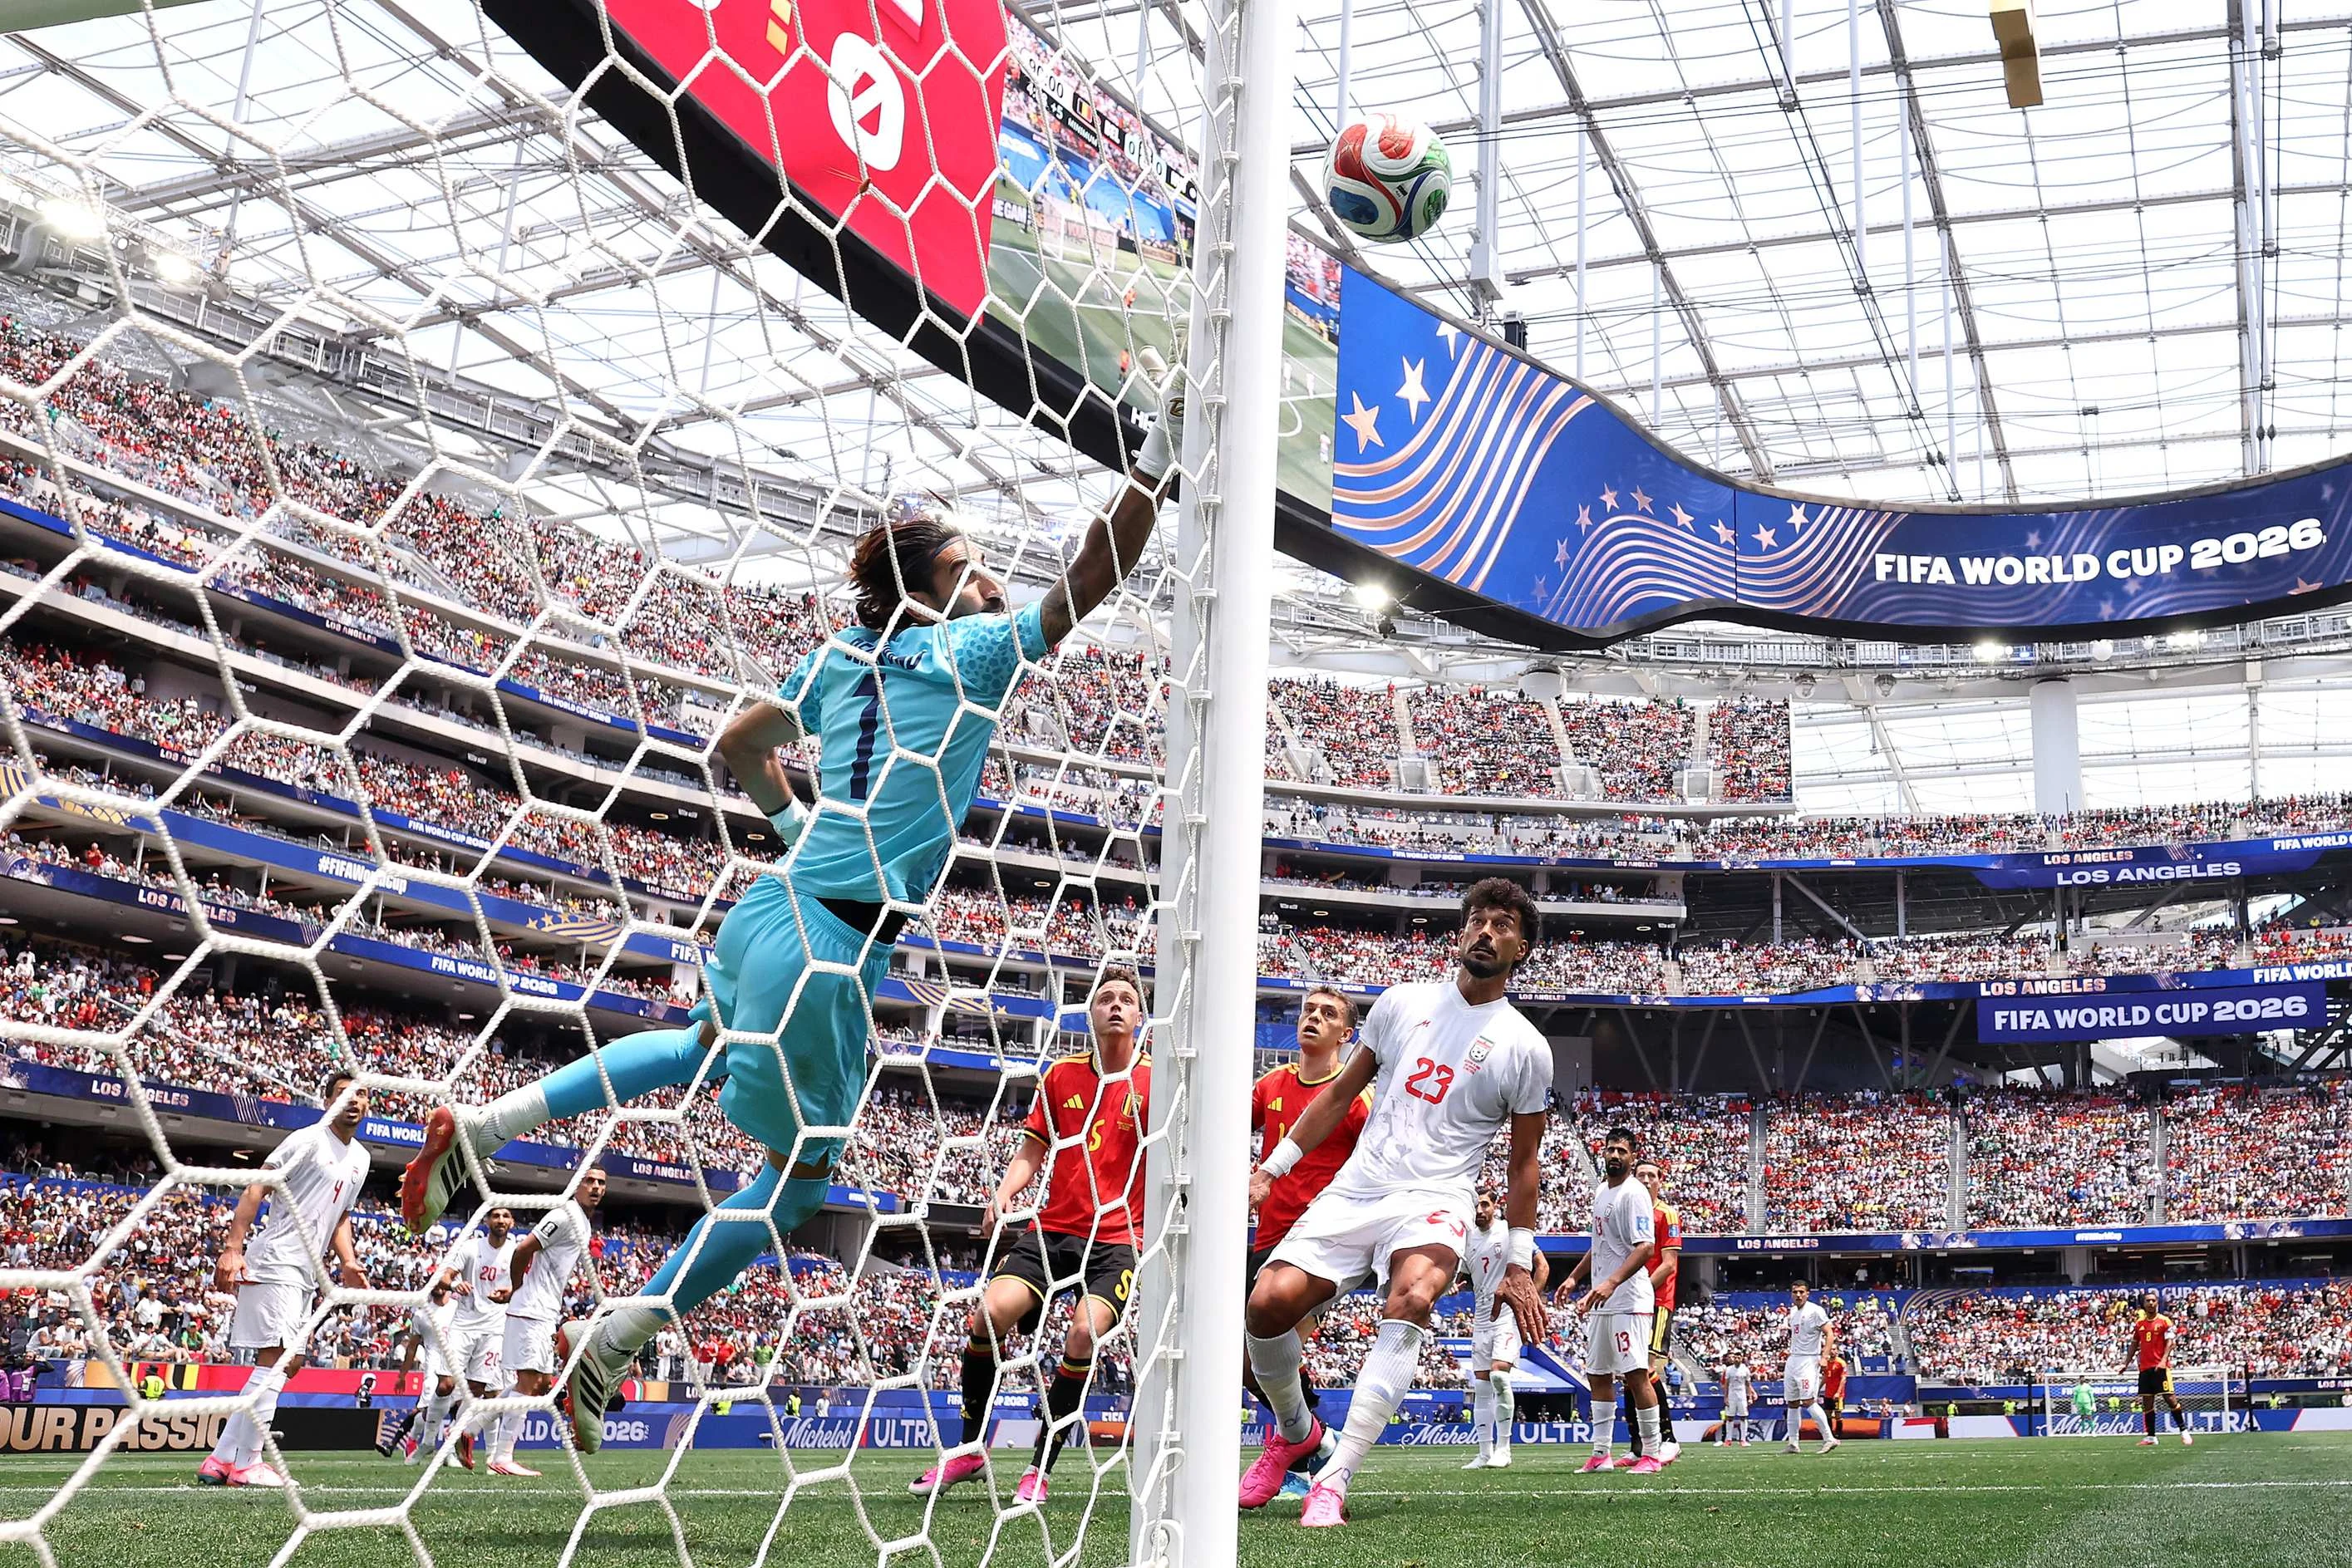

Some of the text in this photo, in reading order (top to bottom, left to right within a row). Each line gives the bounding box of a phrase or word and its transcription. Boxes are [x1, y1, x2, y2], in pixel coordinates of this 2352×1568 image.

[1874, 517, 2325, 585] FIFA WORLD CUP 2026
[539, 693, 554, 705] FIFA
[554, 697, 576, 712] WORLD
[576, 705, 588, 715] CUP
[850, 673, 887, 799] 1
[160, 749, 179, 762] LOS
[408, 820, 425, 832] FIFA
[425, 824, 450, 839] WORLD
[451, 833, 466, 843] CUP
[2273, 839, 2300, 851] FIFA
[2301, 835, 2348, 848] WORLD
[2044, 850, 2133, 865] LOS ANGELES
[2057, 862, 2241, 886] LOS ANGELES
[646, 884, 660, 894] LOS
[138, 888, 237, 923] LOS ANELES
[431, 956, 558, 995] FIFA WORLD UP 2026
[2252, 967, 2292, 984] FIFA
[1980, 978, 2107, 996] LOS ANGELES
[1995, 995, 2308, 1030] FIFA WORLD CUP 2026
[91, 1079, 121, 1097] LOS
[1405, 1057, 1454, 1104] 23
[366, 1122, 391, 1138] FIFA
[1089, 1118, 1105, 1152] 5
[632, 1162, 652, 1175] LOS
[332, 1179, 343, 1204] 4
[1737, 1238, 1819, 1249] LOS ANGELES
[480, 1266, 497, 1281] 20
[1481, 1256, 1490, 1274] 7
[1614, 1331, 1631, 1354] 13
[2145, 1331, 2152, 1342] 8
[2163, 1379, 2169, 1391] 8
[1004, 1396, 1029, 1407] 2026
[602, 1420, 644, 1442] 026
[772, 1415, 854, 1449] Michelob
